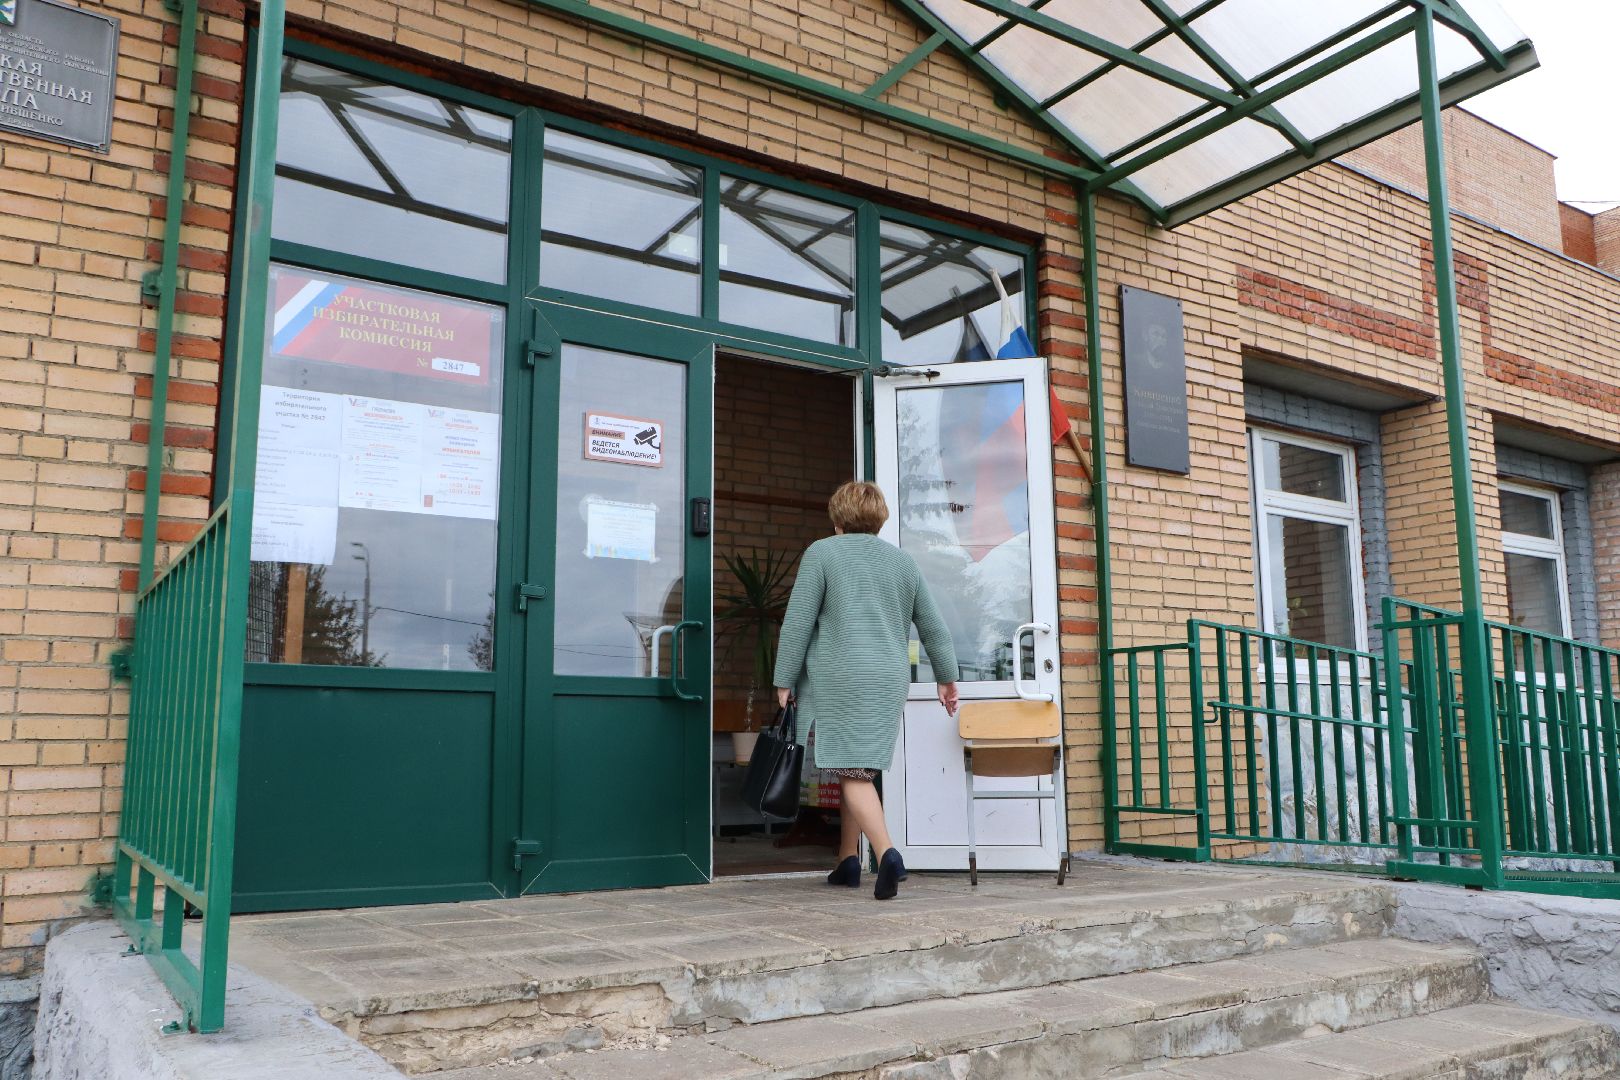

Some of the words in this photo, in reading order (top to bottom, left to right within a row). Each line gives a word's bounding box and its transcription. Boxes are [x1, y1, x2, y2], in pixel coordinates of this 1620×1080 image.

[1, 54, 43, 77] КАЯ
[333, 294, 441, 324] УЧАСТКОВАЯ
[312, 305, 455, 341] ИЗБИРАТЕЛЬНАЯ
[339, 326, 433, 353] КОМИССИЯ
[416, 357, 429, 369] №
[441, 361, 465, 372] 2847
[591, 429, 623, 439] ВНИМАНИЕ
[591, 440, 620, 449] ВЕДЕТСЯ
